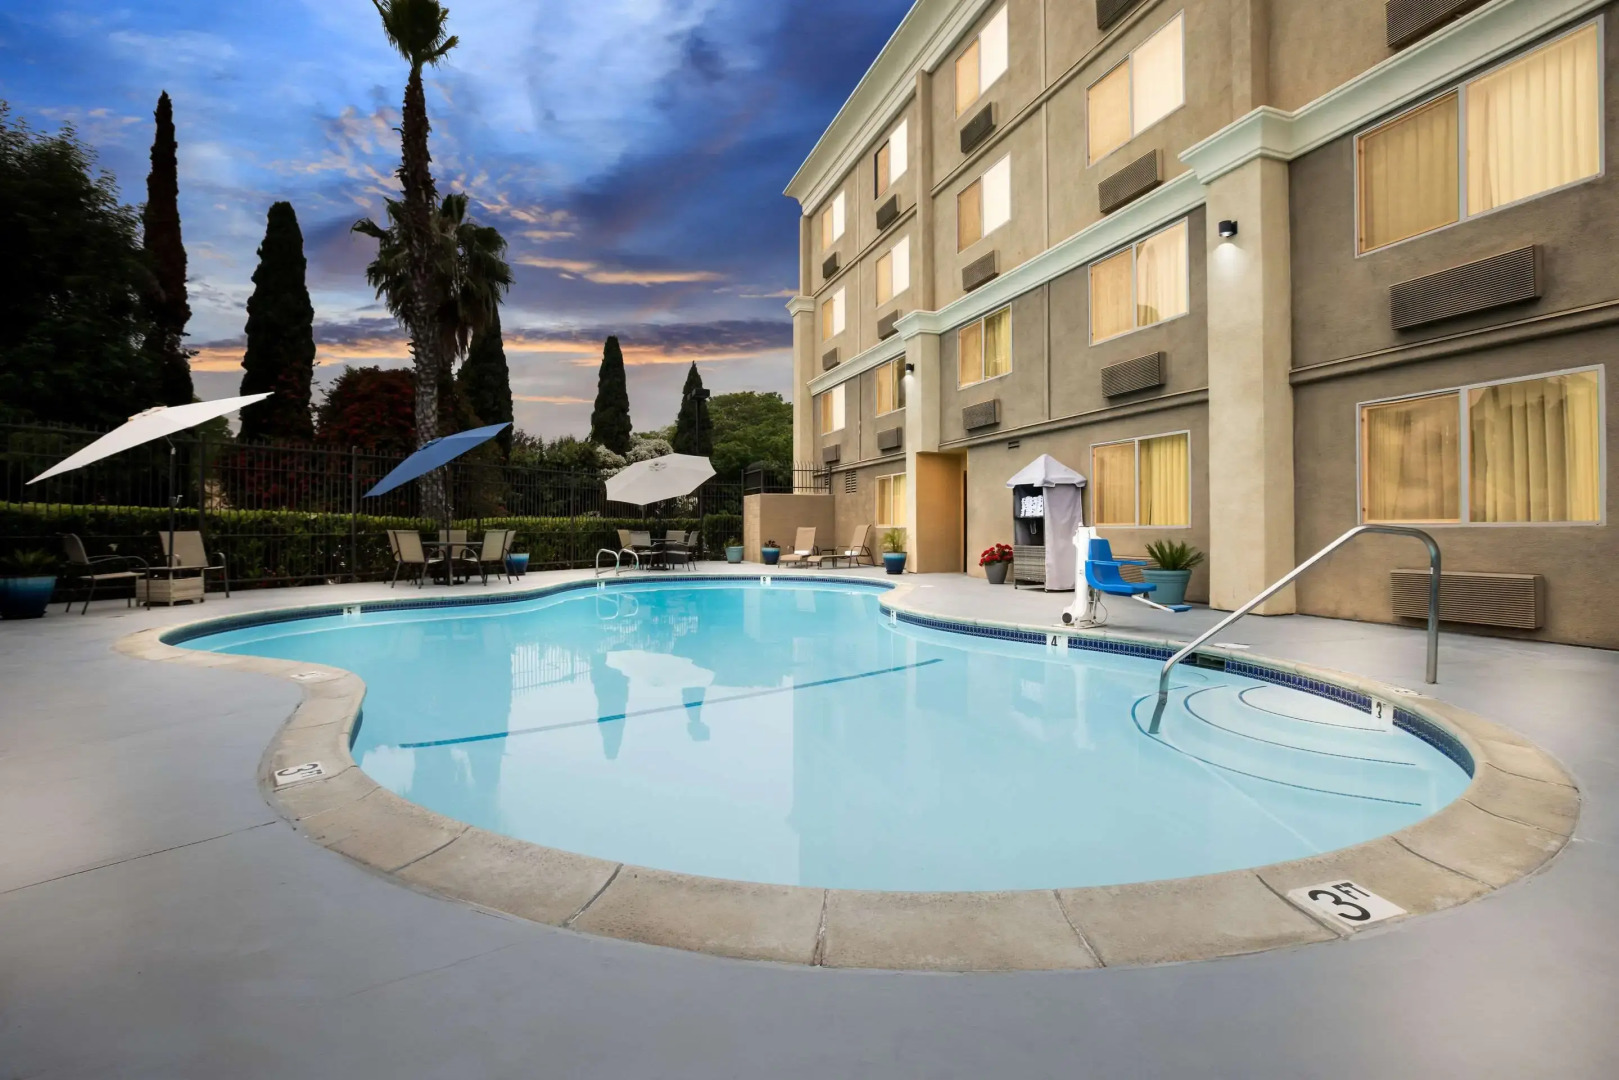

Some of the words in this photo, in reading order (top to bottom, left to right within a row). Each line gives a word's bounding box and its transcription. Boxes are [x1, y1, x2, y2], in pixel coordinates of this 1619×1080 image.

[1051, 635, 1058, 646] 4
[1376, 701, 1382, 719] 3
[277, 763, 319, 777] 3
[1331, 882, 1371, 900] FT
[1308, 889, 1371, 922] 3
